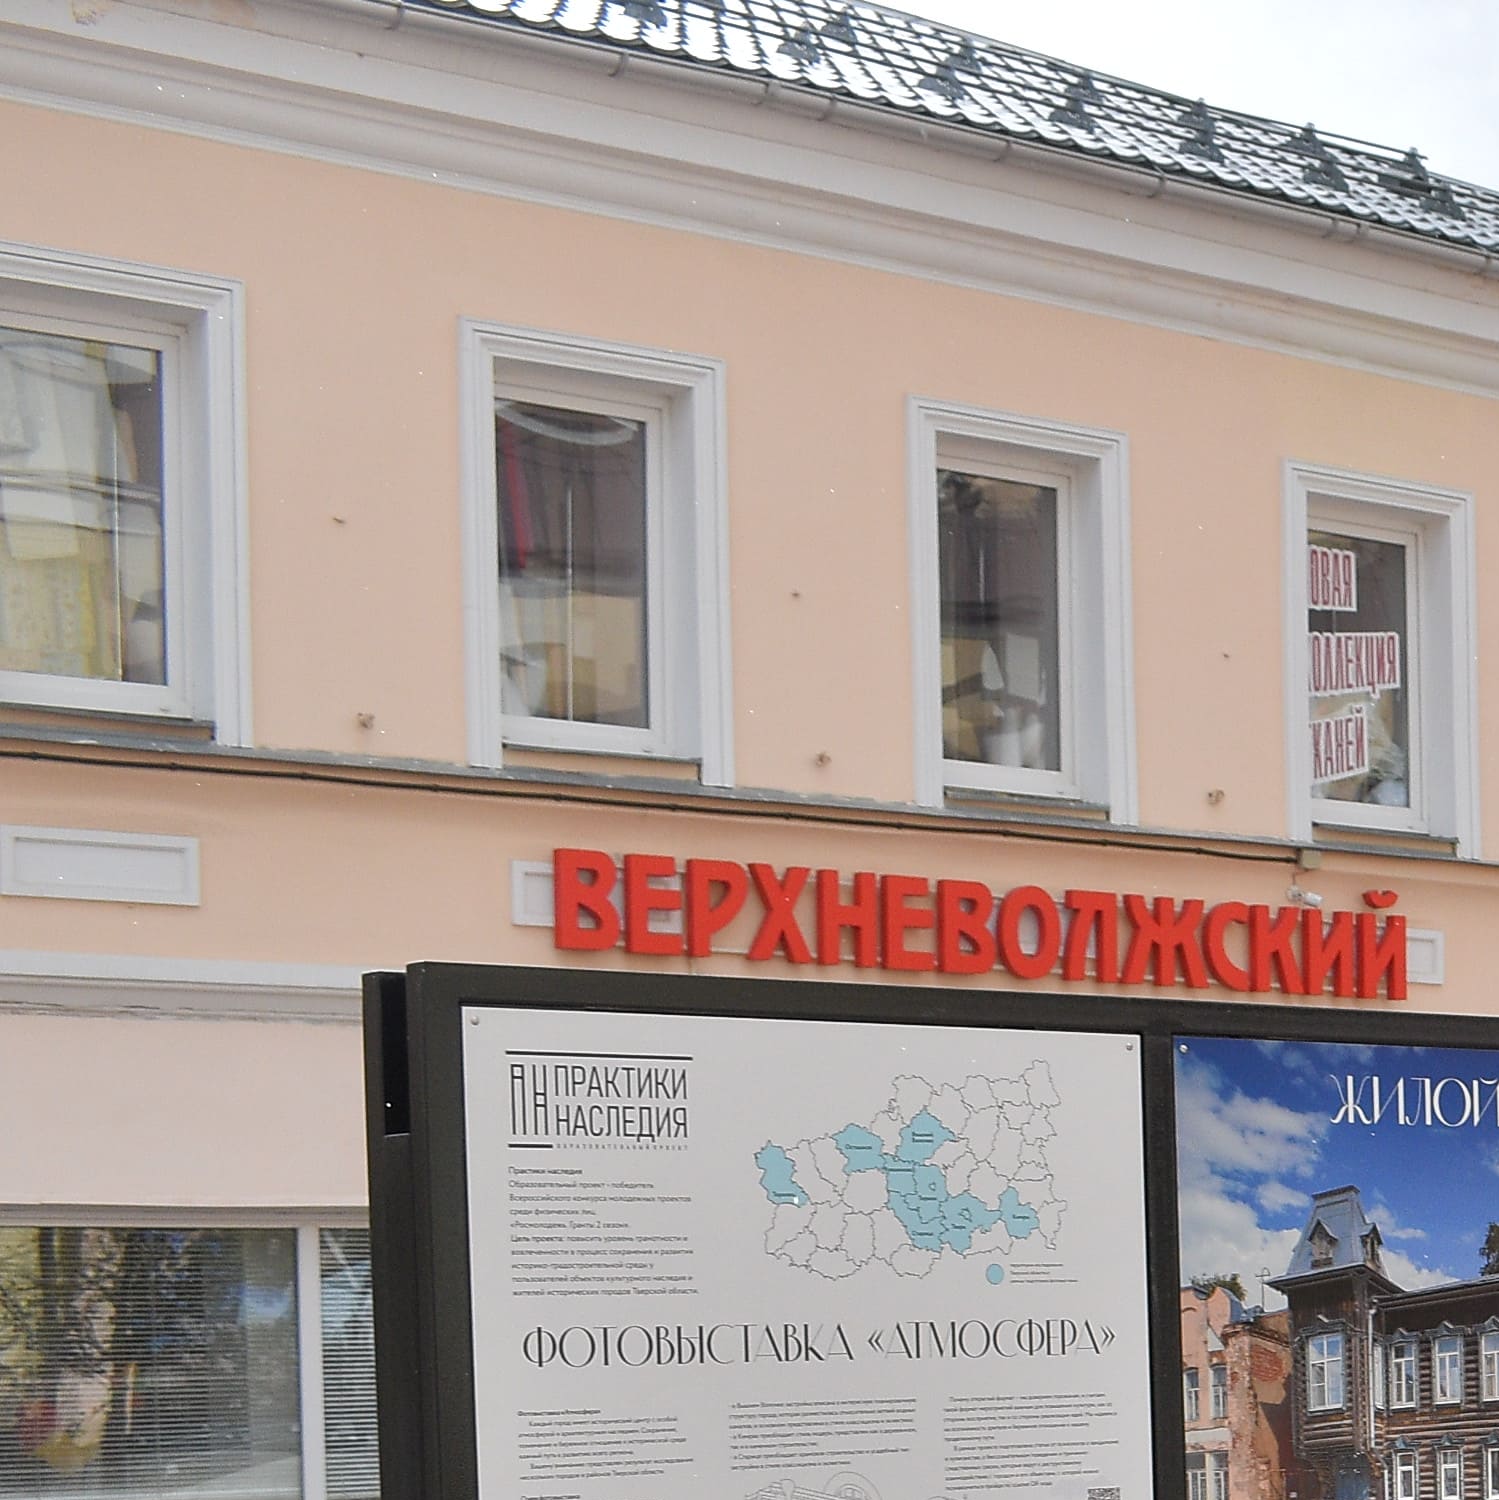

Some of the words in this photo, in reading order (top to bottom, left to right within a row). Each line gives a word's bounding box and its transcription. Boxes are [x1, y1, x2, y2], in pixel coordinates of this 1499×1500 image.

[1309, 547, 1355, 608] ОВАЯ
[1308, 635, 1397, 698] ОЛЛЕКЦИЯ
[1308, 705, 1367, 781] КАНЕЙ
[553, 848, 1408, 1001] ВЕРХНЕВОЛЖСКИЙ
[554, 1065, 688, 1099] ПРАКТИКИ
[555, 1104, 688, 1143] НАСЛЕДИЯ
[522, 1322, 854, 1369] ФОТОВЫСТАВКА
[867, 1318, 1116, 1362] «АТМОСФЕРА»
